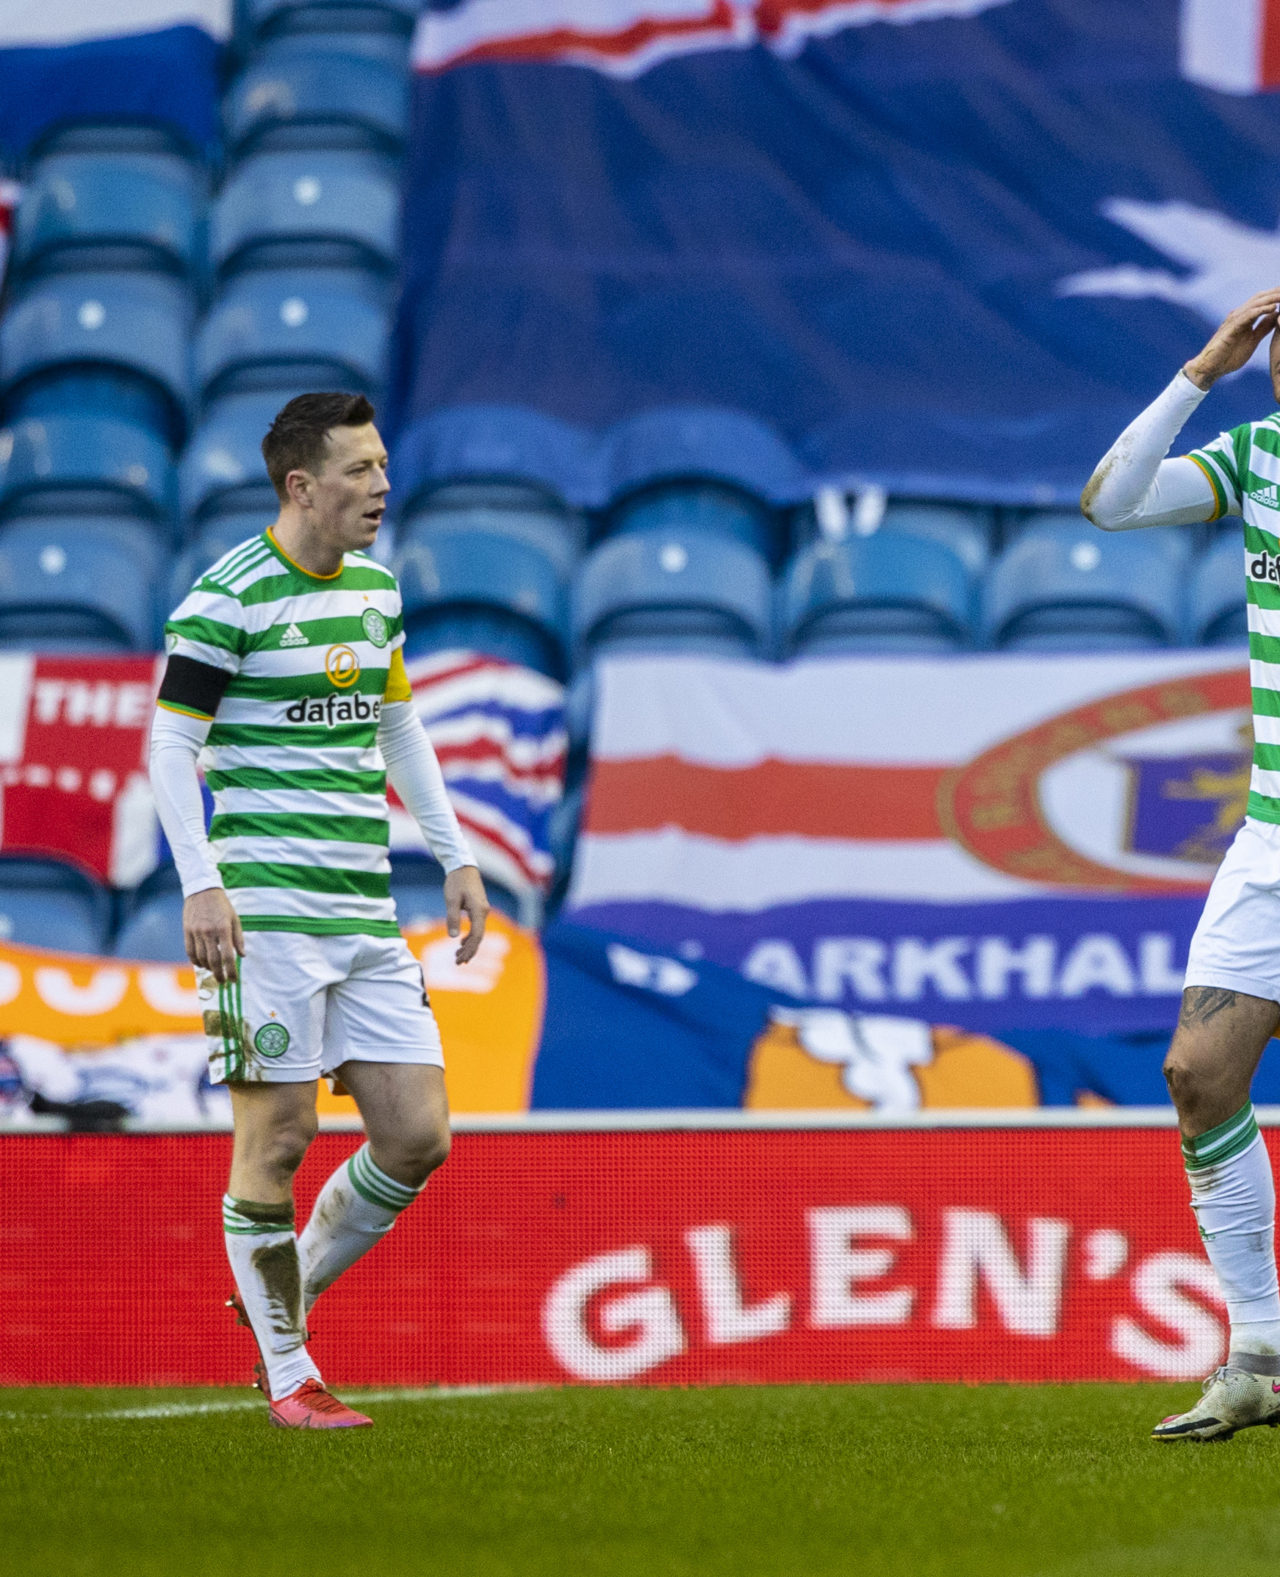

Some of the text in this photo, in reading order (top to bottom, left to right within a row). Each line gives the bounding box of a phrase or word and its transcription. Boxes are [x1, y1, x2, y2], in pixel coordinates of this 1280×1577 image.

[1250, 490, 1280, 509] adidas
[35, 679, 155, 729] THE
[540, 1204, 1232, 1383] GLEN'S
